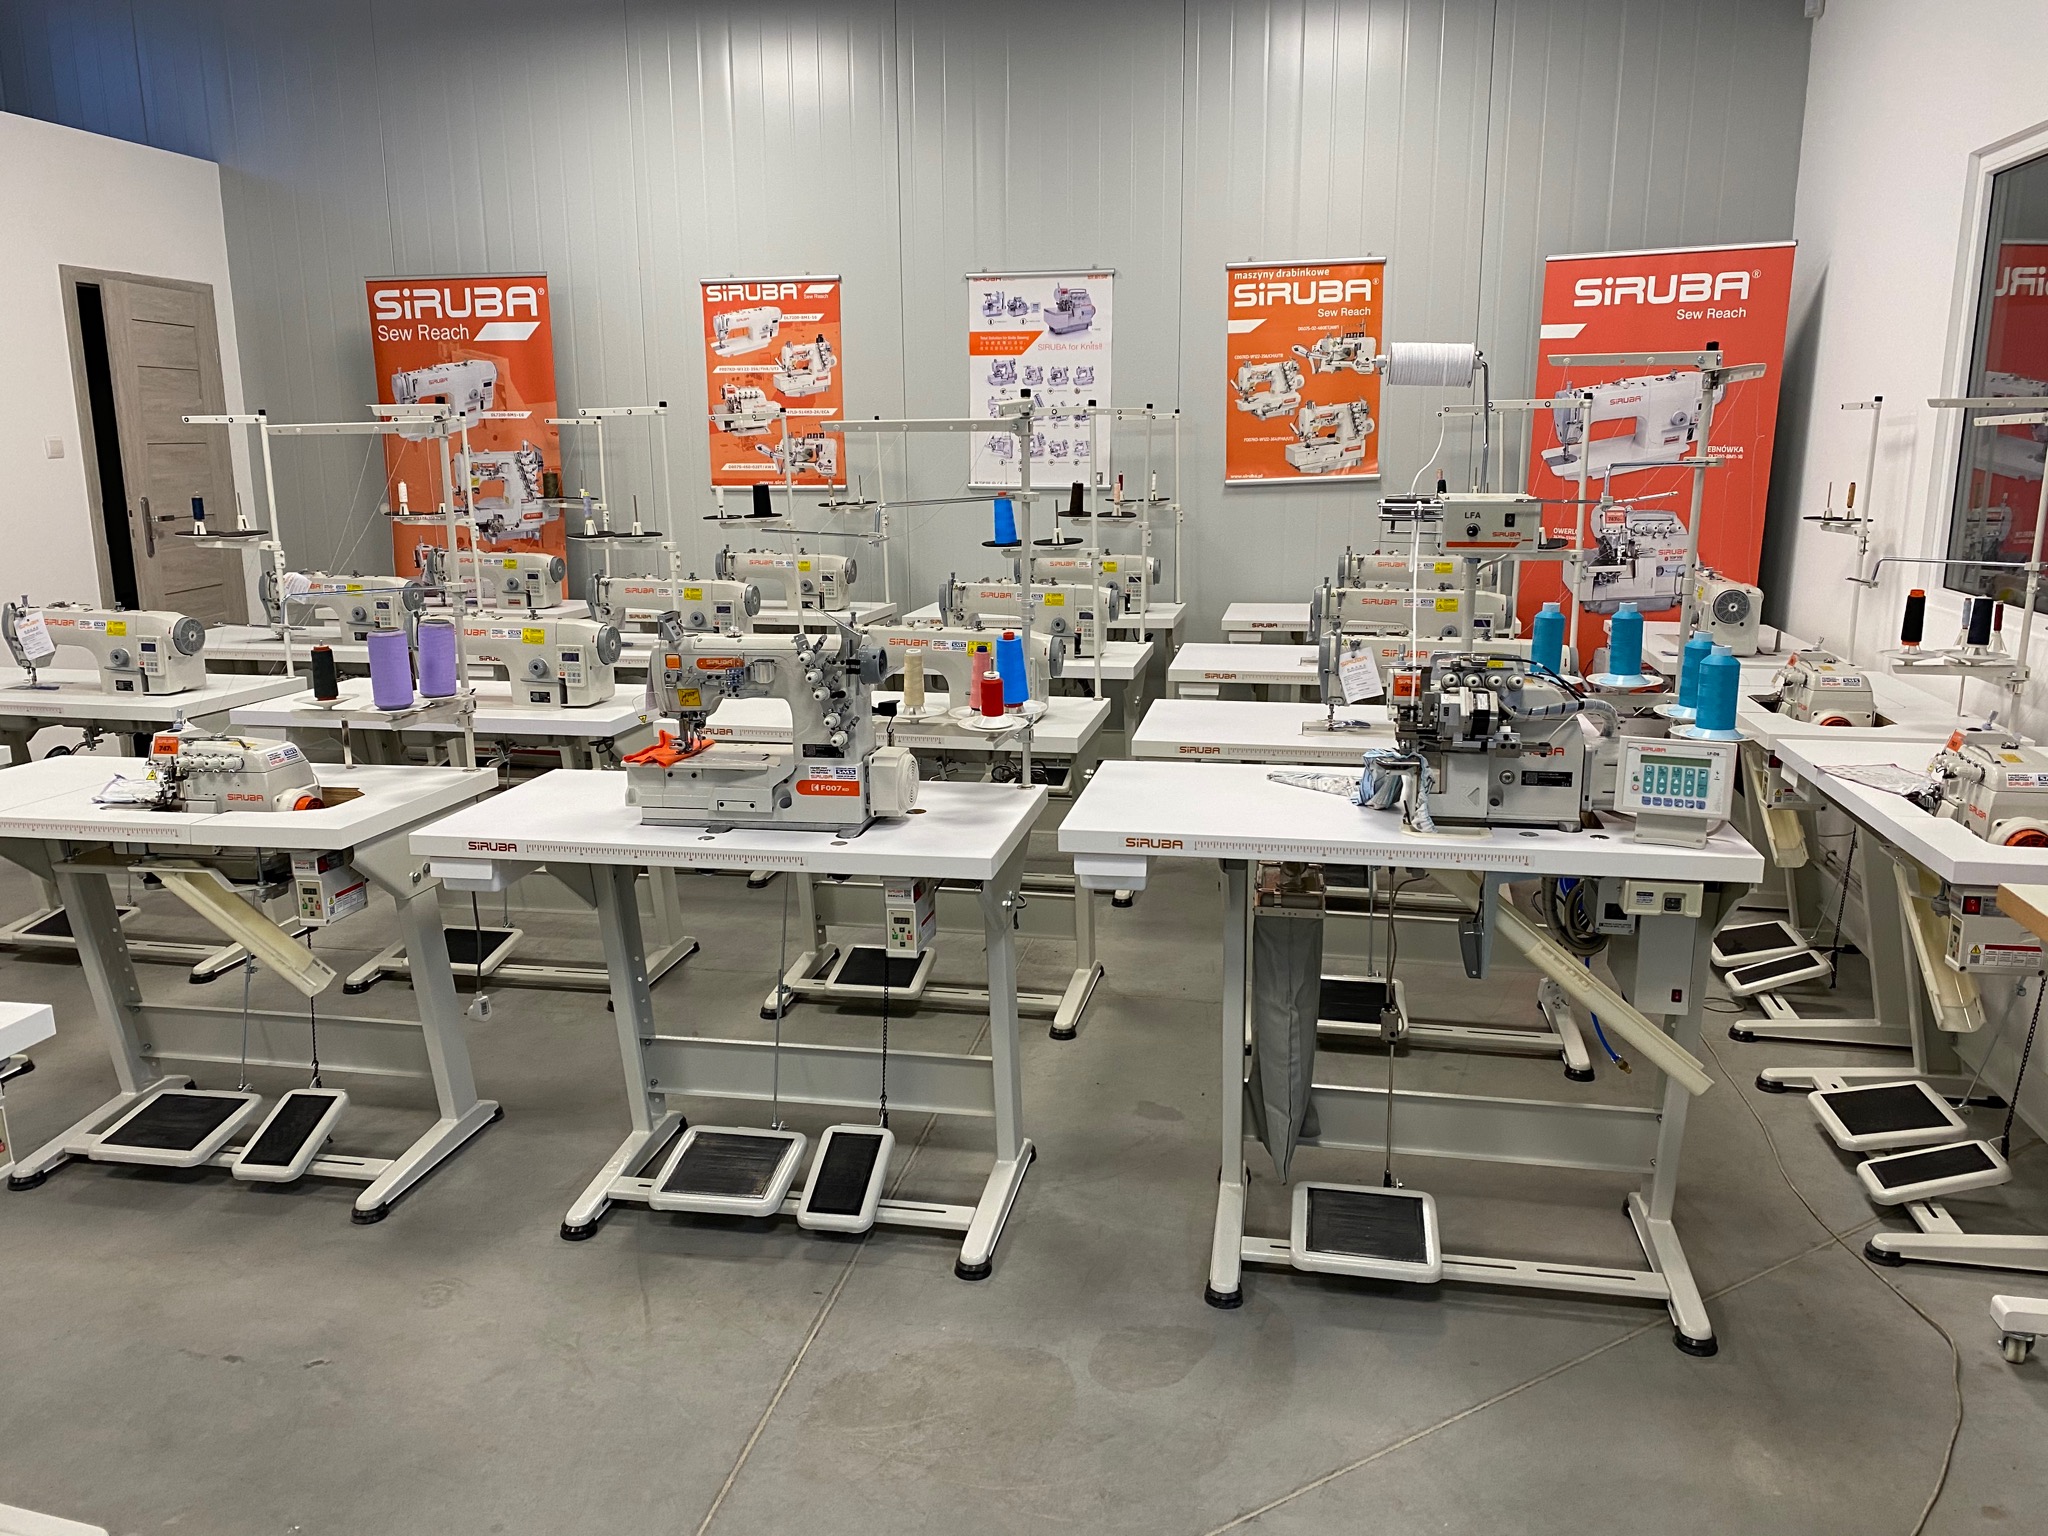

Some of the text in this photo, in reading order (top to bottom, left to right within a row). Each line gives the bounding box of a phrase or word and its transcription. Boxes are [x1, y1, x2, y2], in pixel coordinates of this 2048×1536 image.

[1234, 268, 1330, 280] maszyny drabinkowe
[1317, 307, 1371, 318] Sew Reach
[1675, 307, 1747, 320] Sew Reach
[378, 323, 470, 342] Sew Reach
[1707, 445, 1744, 453] EBNÓWKA
